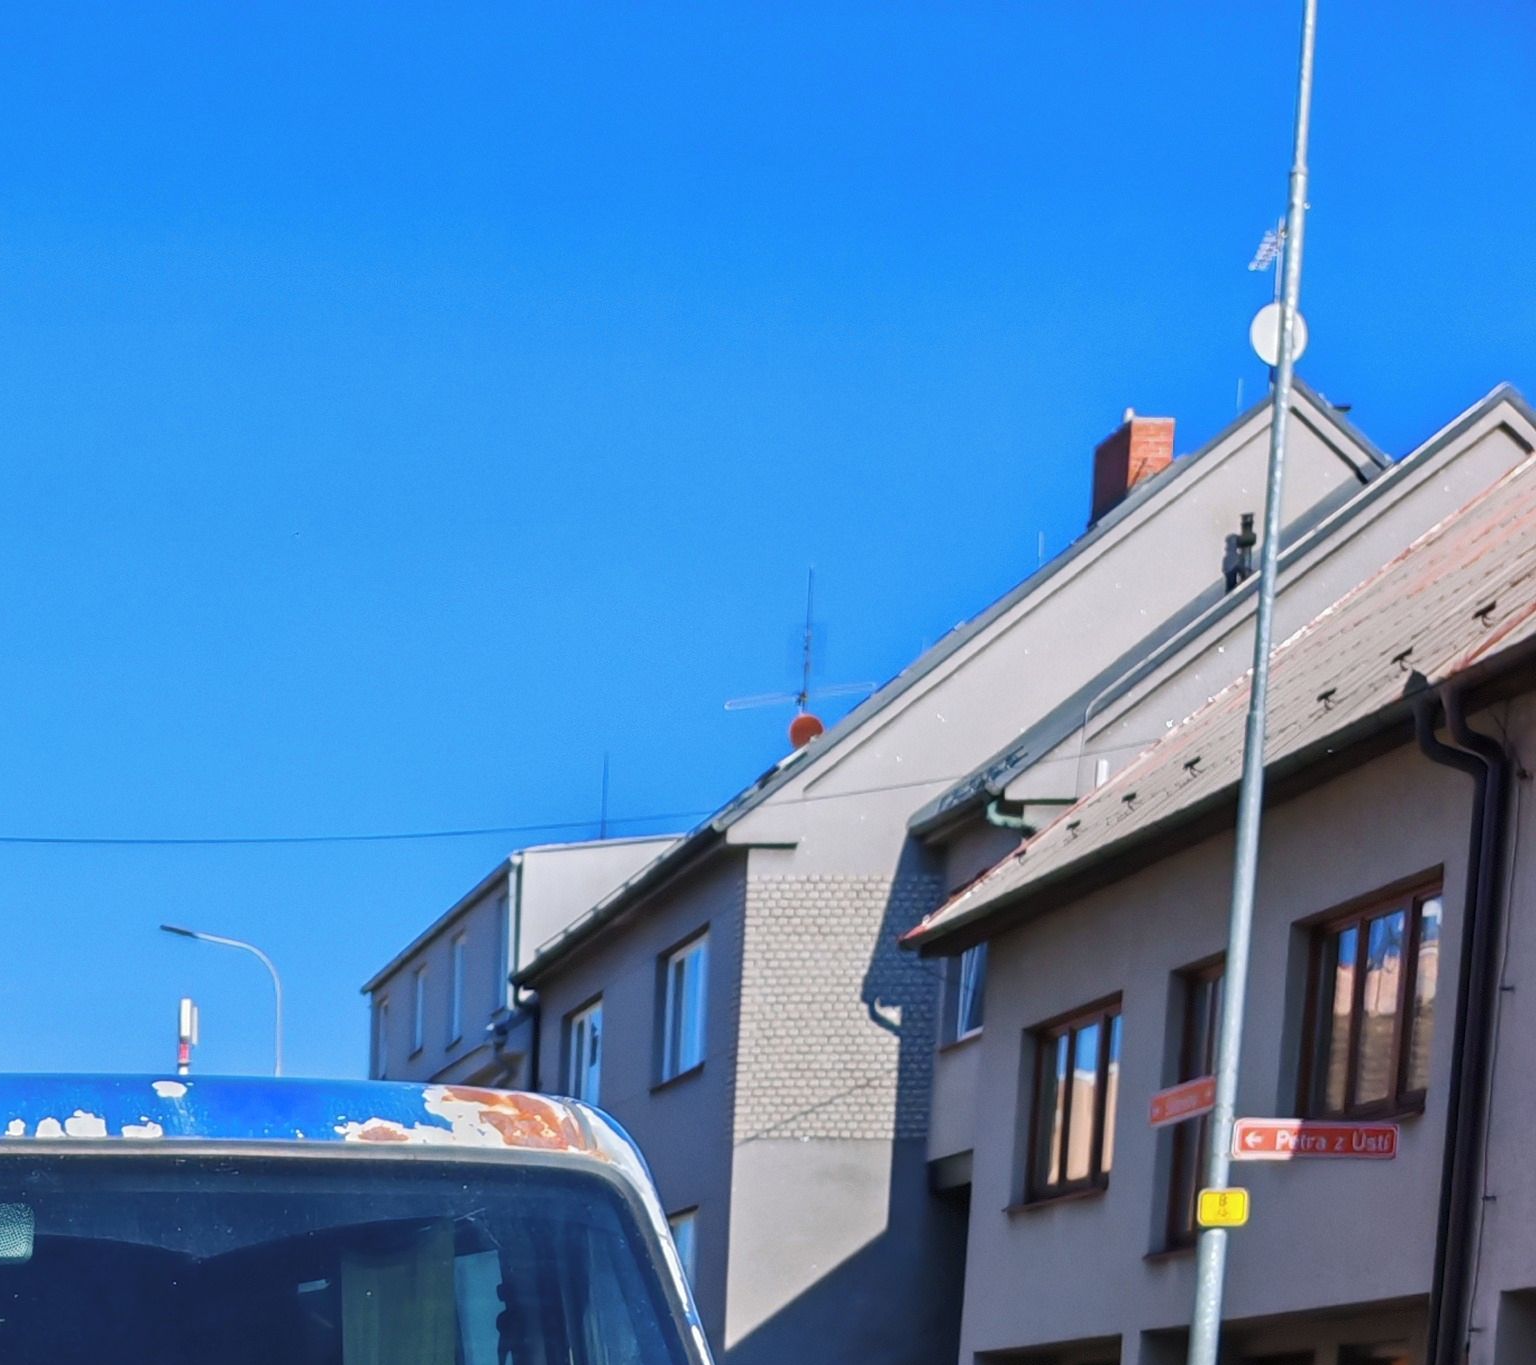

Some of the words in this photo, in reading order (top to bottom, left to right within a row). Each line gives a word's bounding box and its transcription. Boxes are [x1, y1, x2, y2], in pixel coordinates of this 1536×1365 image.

[1275, 1129, 1327, 1151] Petra
[1334, 1137, 1344, 1151] z
[1352, 1128, 1390, 1151] Ústí
